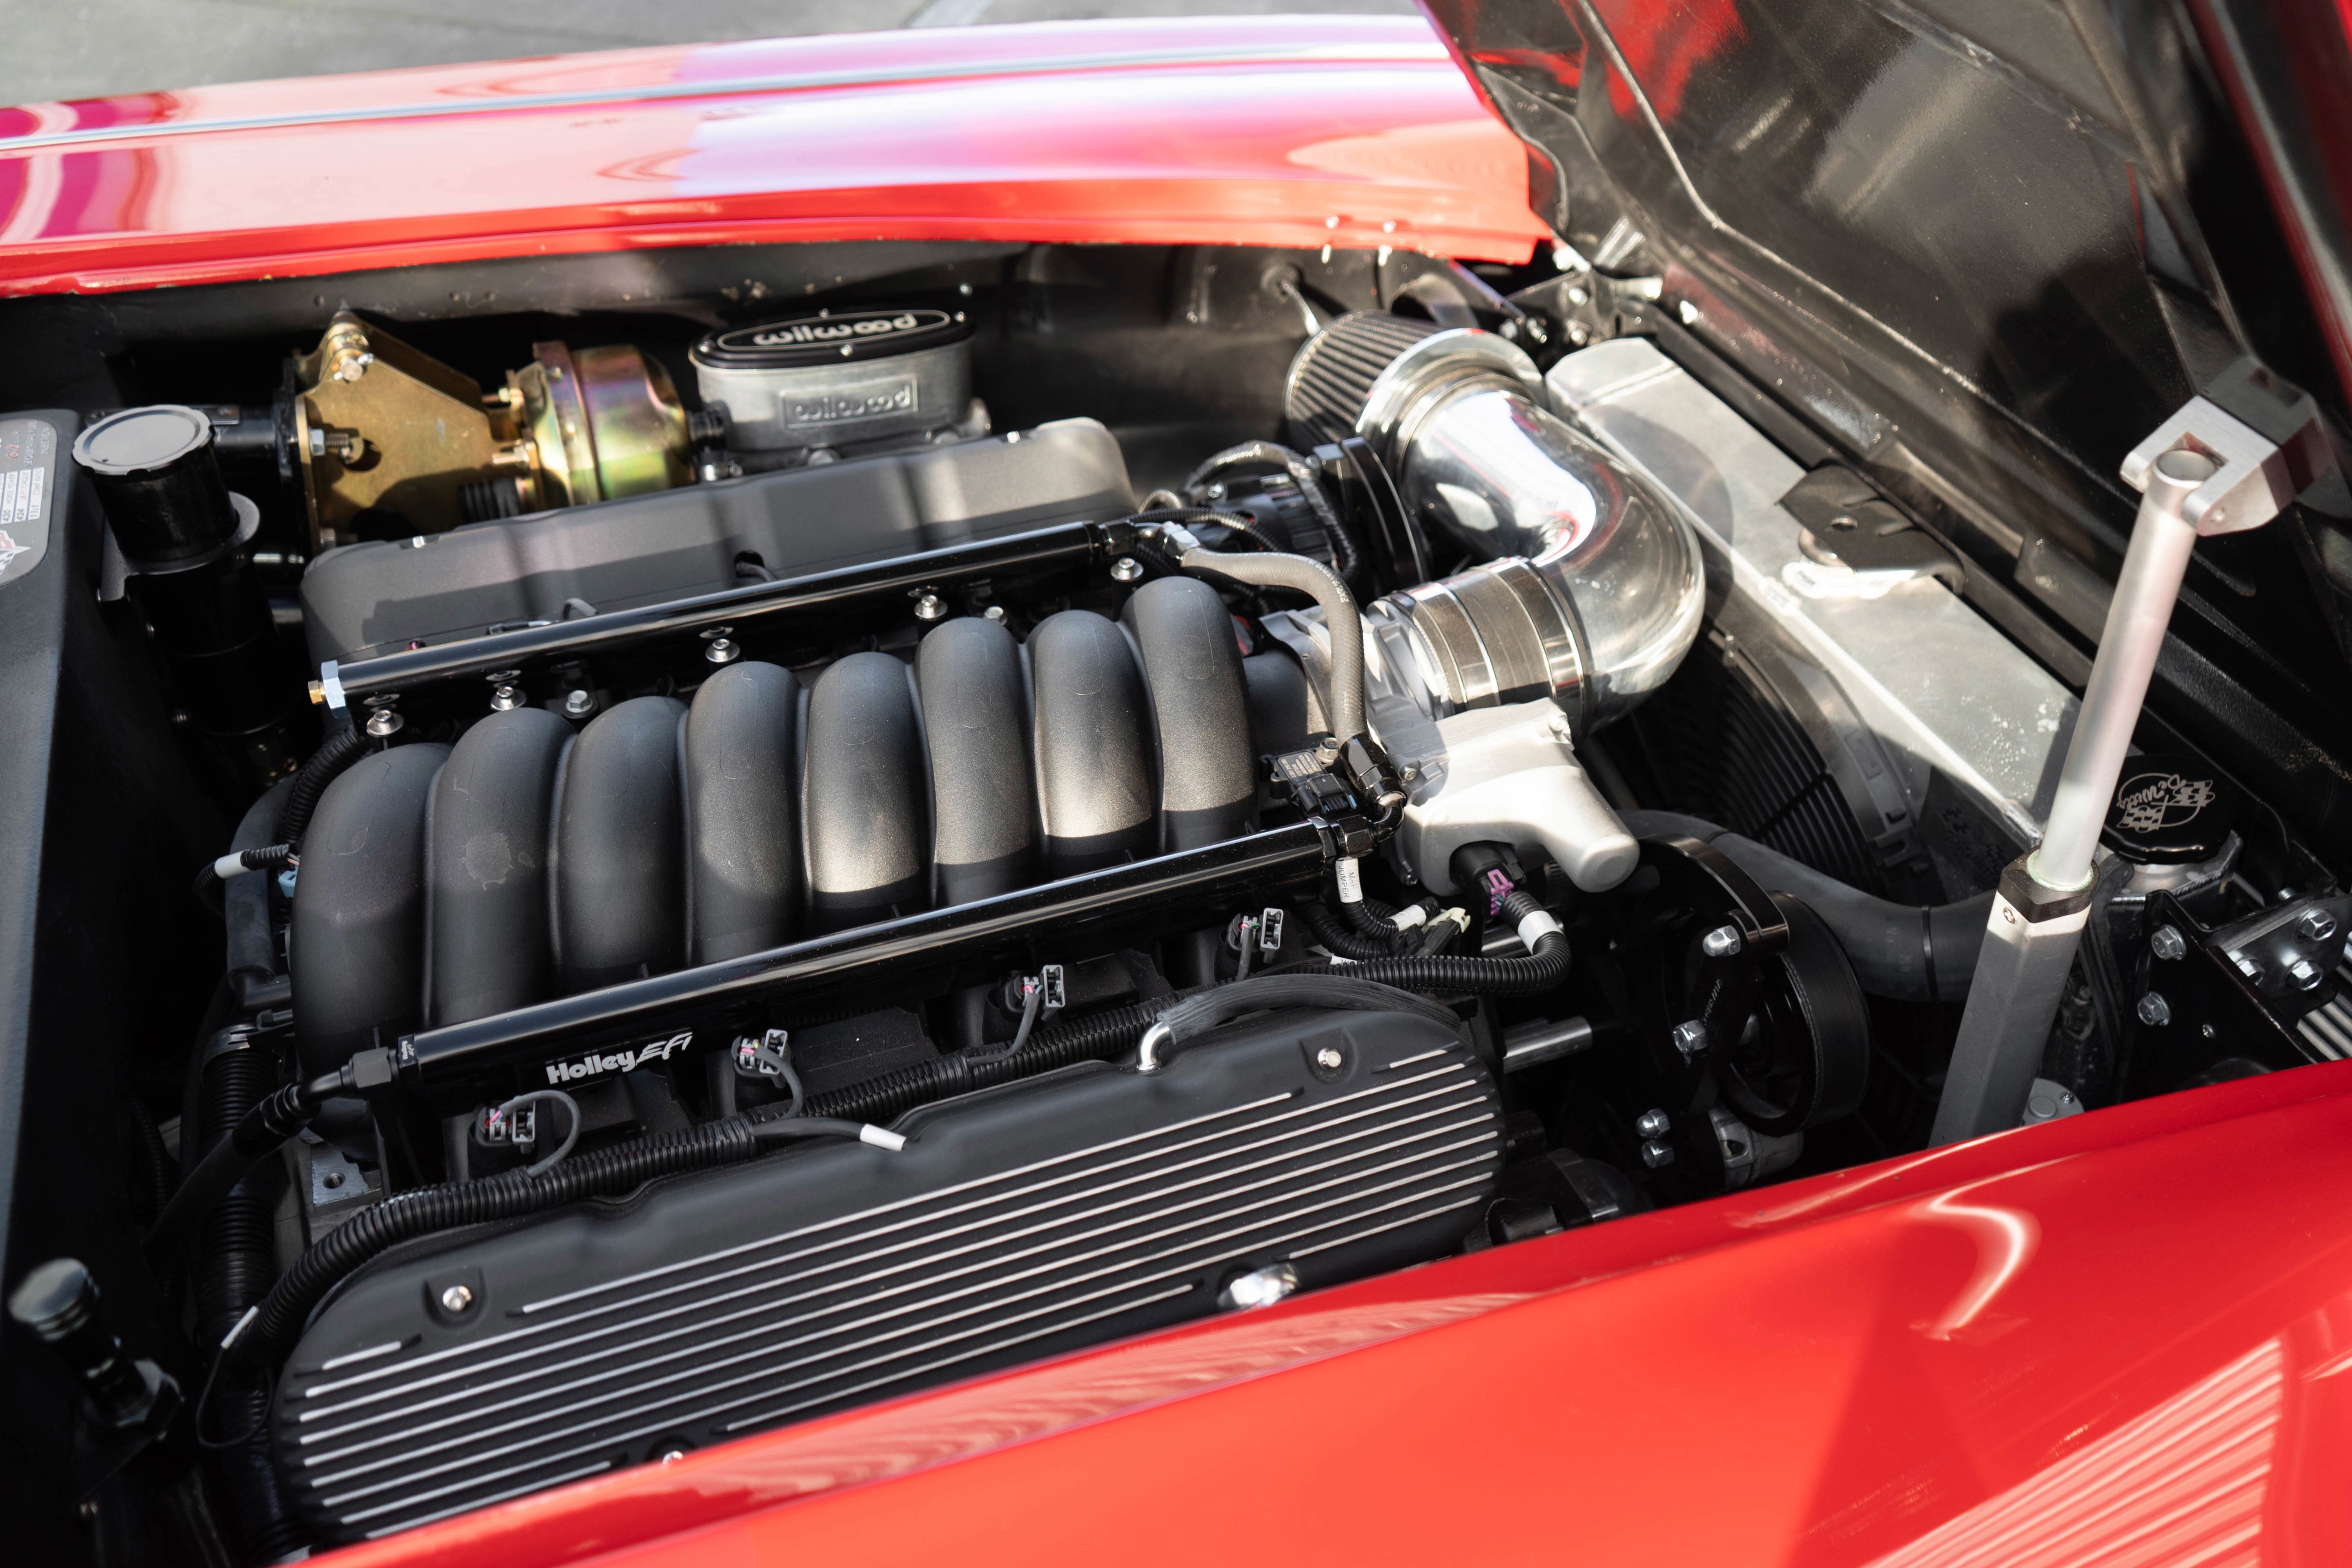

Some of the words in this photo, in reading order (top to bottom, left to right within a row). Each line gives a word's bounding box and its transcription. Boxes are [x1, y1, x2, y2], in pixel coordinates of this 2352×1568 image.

[752, 312, 918, 345] wilwood
[795, 384, 911, 421] wilwood
[8, 444, 19, 458] 6.2
[2, 510, 11, 521] 430
[16, 508, 24, 521] 424
[30, 505, 39, 517] 11:1
[1339, 866, 1350, 898] JUMPER
[1348, 872, 1357, 889] MAP
[546, 1050, 636, 1085] Holley
[635, 1031, 693, 1066] EFI
